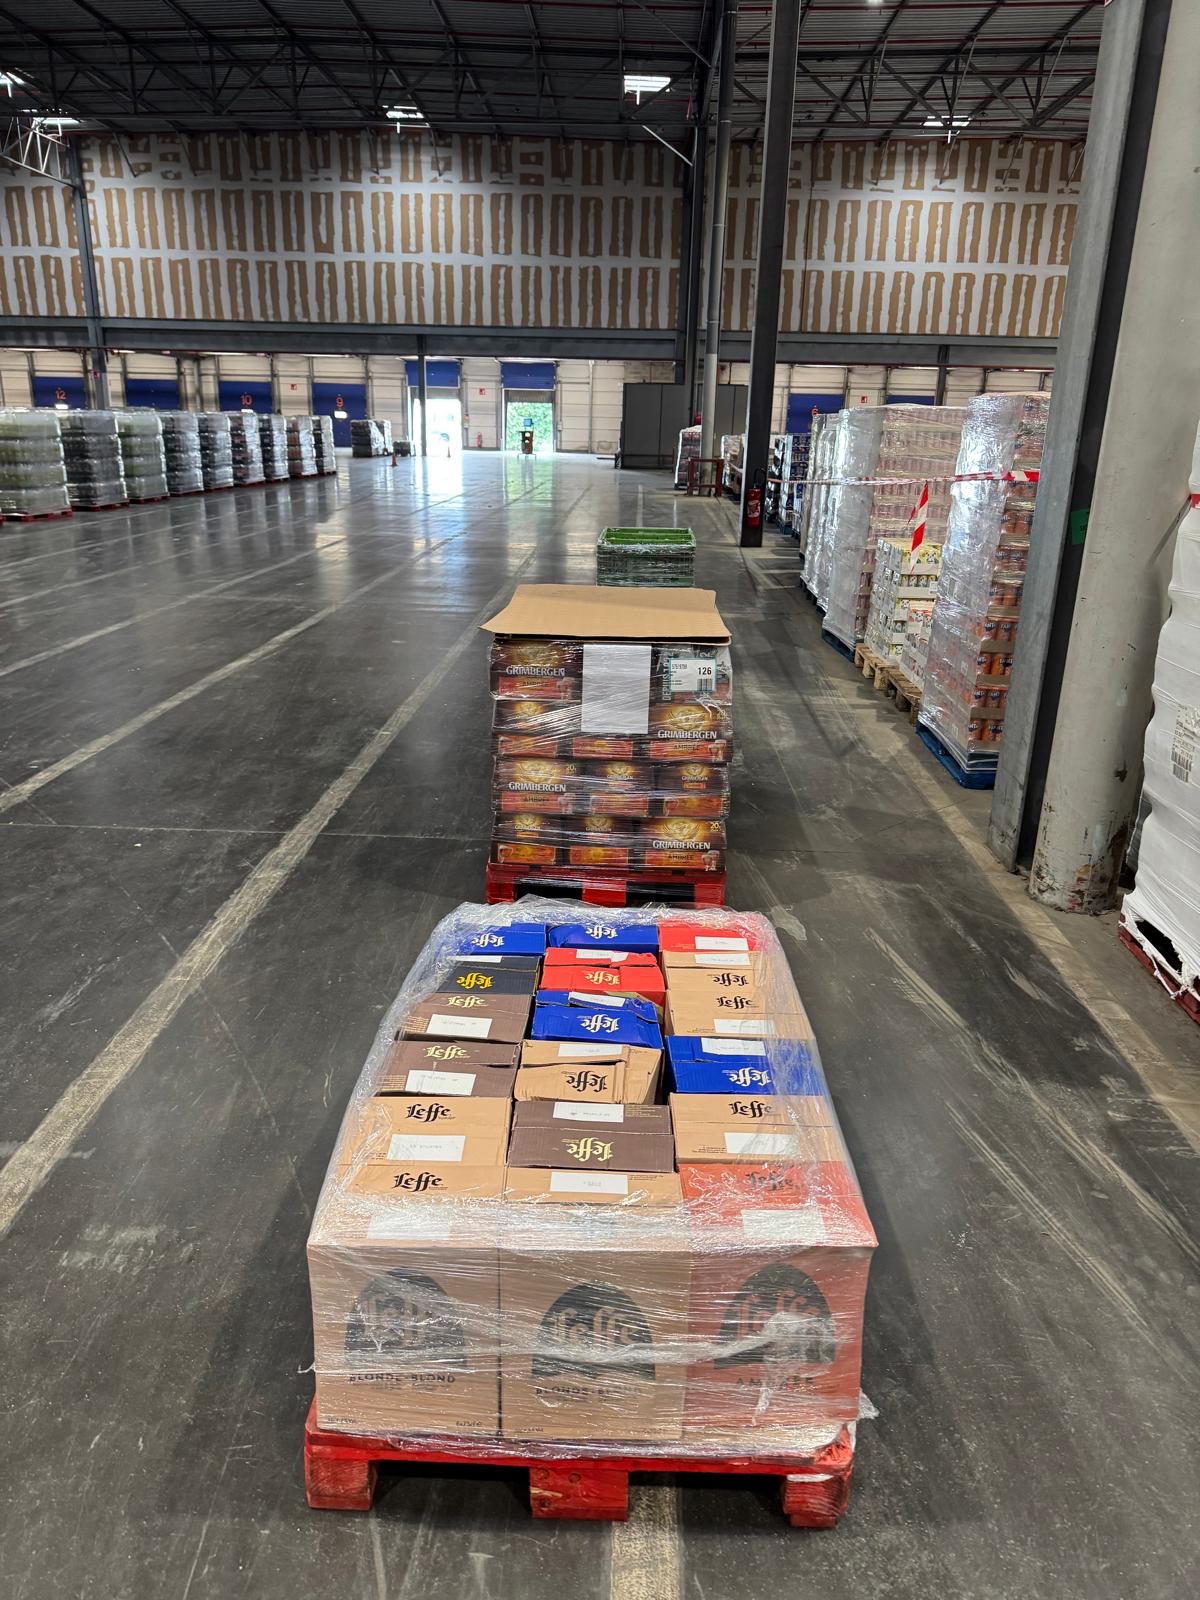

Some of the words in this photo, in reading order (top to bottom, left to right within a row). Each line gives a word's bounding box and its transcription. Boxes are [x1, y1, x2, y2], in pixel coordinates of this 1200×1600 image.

[55, 390, 66, 400] 12
[240, 394, 253, 405] 10
[335, 396, 344, 408] 9
[506, 665, 566, 677] GRIMBERGEN
[698, 667, 712, 676] 126
[657, 729, 717, 739] GRIMBERGEN
[508, 781, 567, 792] GRIMBERGEN
[652, 840, 711, 850] GRIMBERGEN
[585, 924, 618, 939] Leffe
[472, 932, 505, 947] Leffe
[456, 972, 494, 989] Leffe
[585, 970, 620, 985] Leffe
[713, 972, 749, 987] Leffe
[448, 995, 486, 1008] Leffe
[717, 995, 753, 1010] Leffe
[580, 1013, 620, 1033] Leffe
[424, 1045, 468, 1060] Leffe
[566, 1070, 608, 1092] Leffe
[729, 1067, 772, 1086] Leffe
[405, 1102, 451, 1122] Leffe
[728, 1100, 773, 1118] Leffe
[566, 1137, 614, 1161] Leffe
[392, 1171, 442, 1193] Leffe
